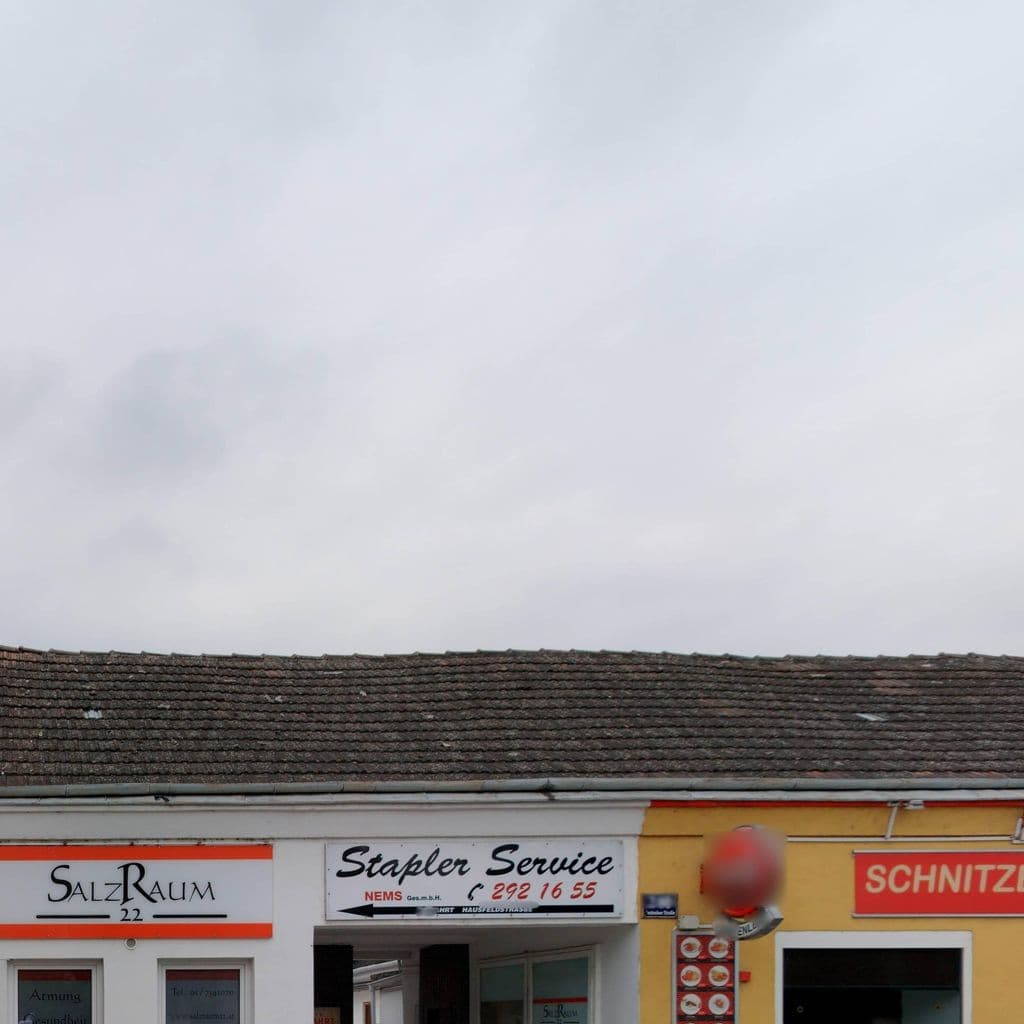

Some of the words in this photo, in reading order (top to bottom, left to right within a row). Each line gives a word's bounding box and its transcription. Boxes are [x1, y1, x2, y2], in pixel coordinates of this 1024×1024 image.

[336, 845, 471, 886] Stapler
[485, 843, 615, 876] Service
[364, 891, 403, 901] NEMS
[491, 882, 531, 900] 292
[539, 882, 563, 900] 16
[569, 881, 598, 899] 55
[120, 908, 144, 922] 22
